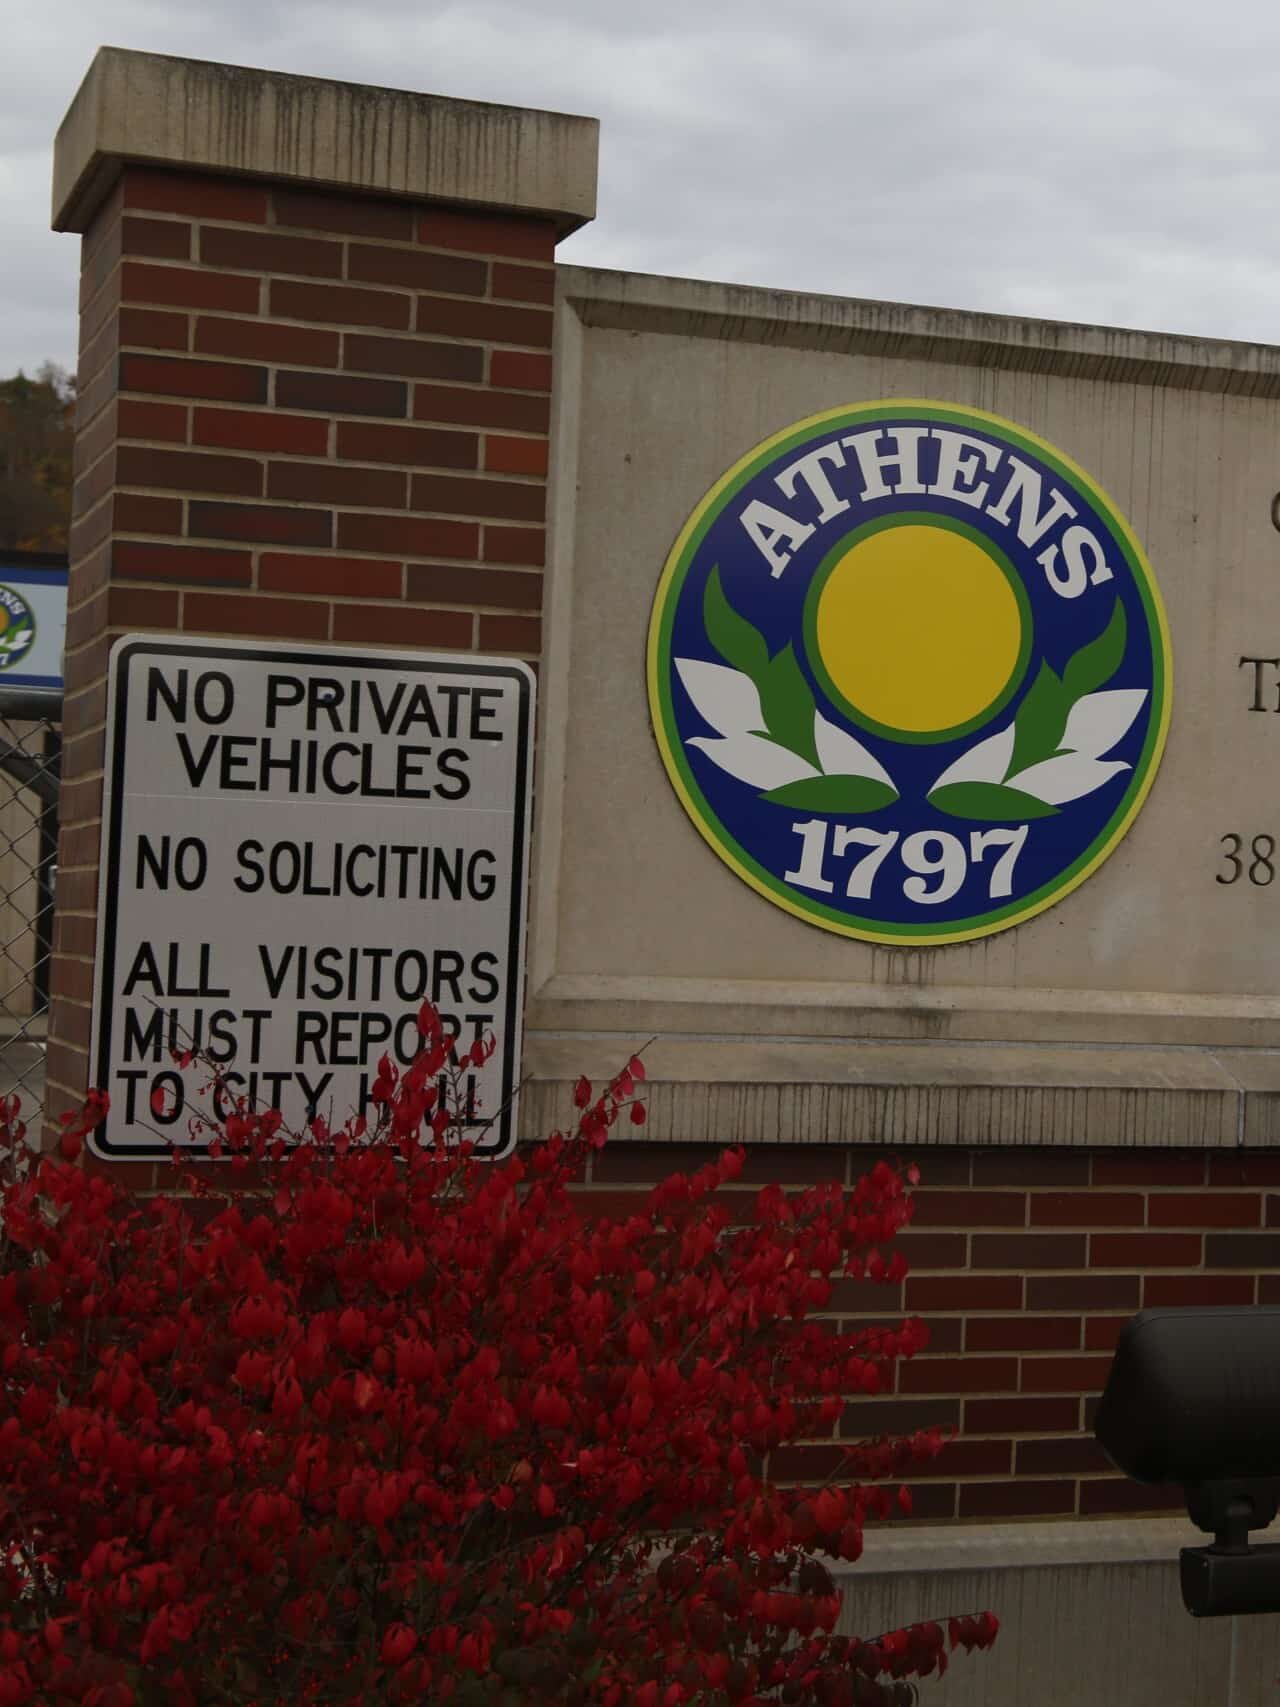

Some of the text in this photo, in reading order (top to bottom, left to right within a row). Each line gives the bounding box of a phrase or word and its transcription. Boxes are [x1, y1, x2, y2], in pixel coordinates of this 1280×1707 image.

[739, 426, 1114, 600] ATHENS
[147, 668, 503, 741] NO PRIVATE
[176, 733, 471, 799] VEHICLES
[135, 834, 497, 901] NO SOLICITING
[784, 818, 1030, 905] 1797
[1215, 833, 1277, 887] 38
[123, 941, 499, 1003] ALL VISITORS
[123, 1007, 271, 1064] MUST
[117, 1070, 493, 1127] TO CITY HLL
